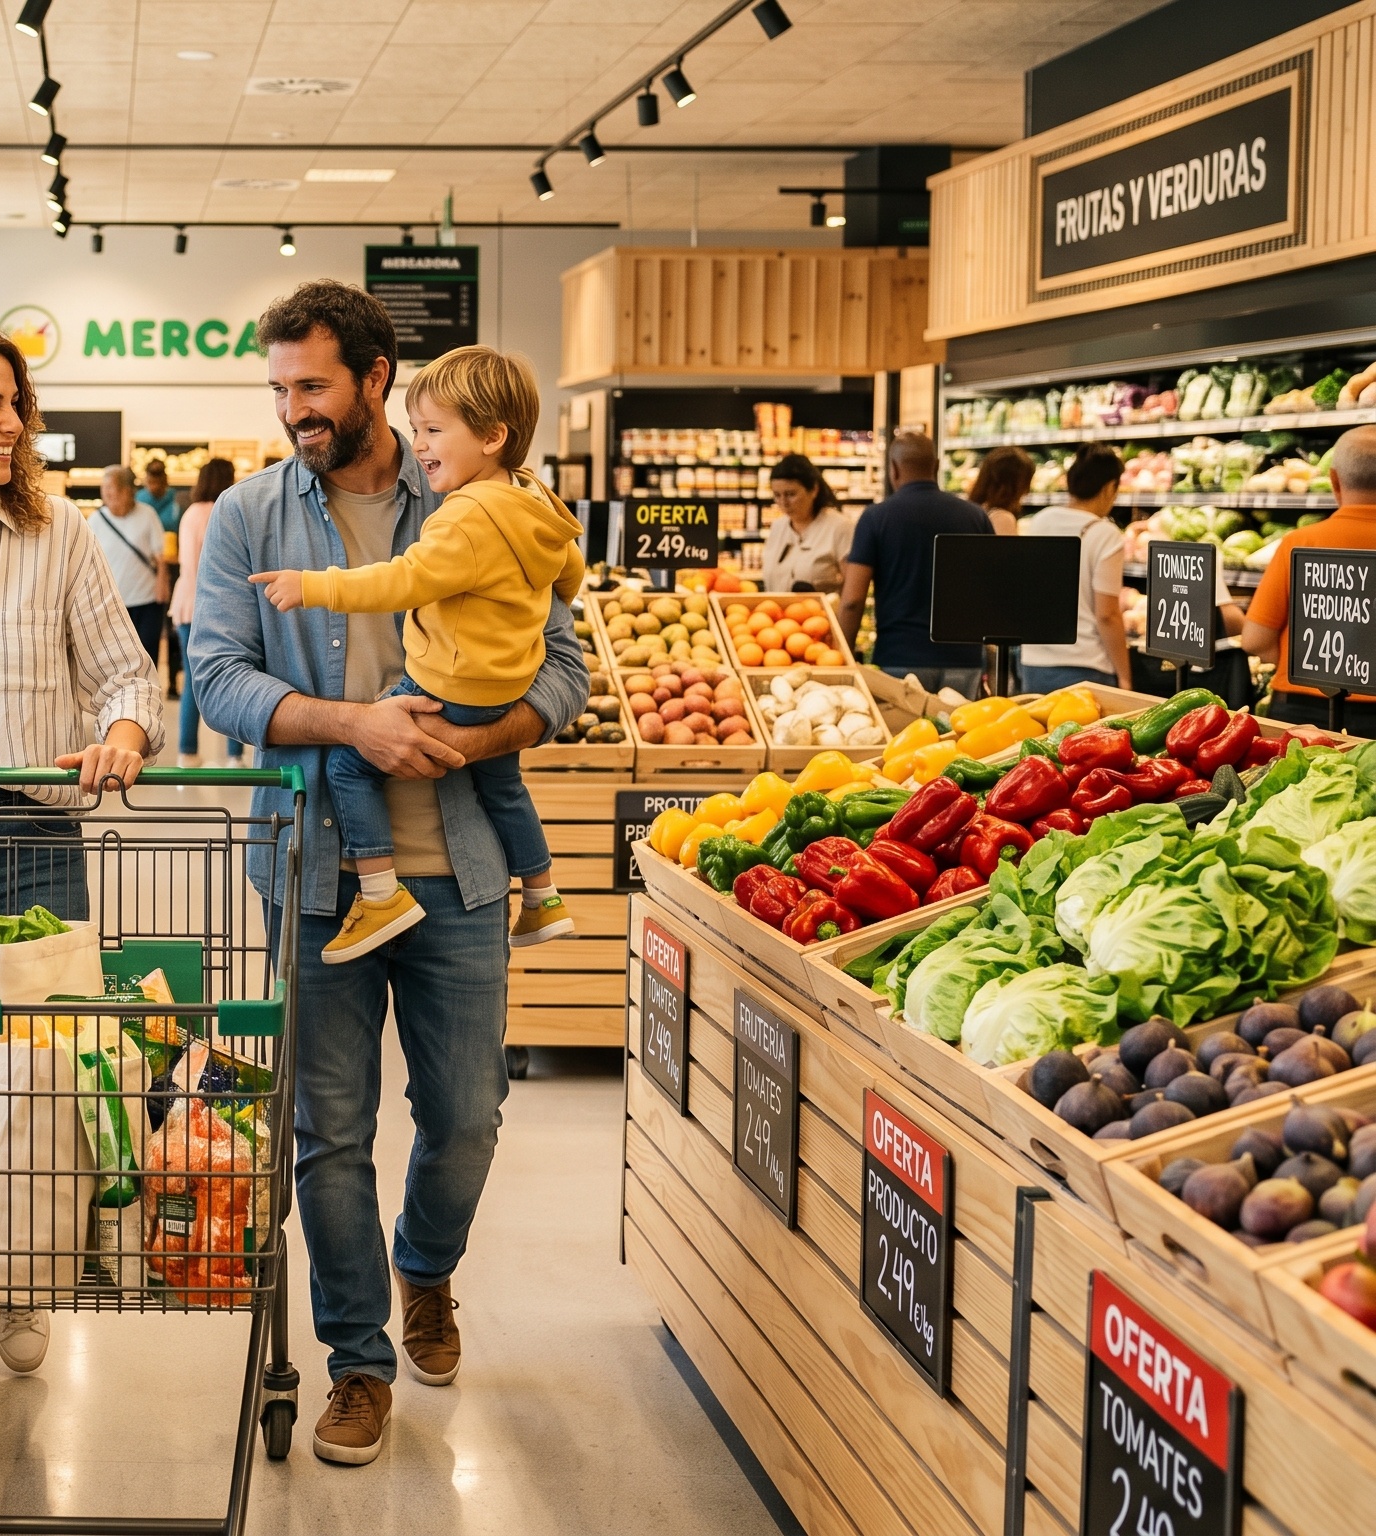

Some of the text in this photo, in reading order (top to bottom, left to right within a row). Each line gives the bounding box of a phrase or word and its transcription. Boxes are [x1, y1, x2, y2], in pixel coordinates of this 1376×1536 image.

[1055, 136, 1267, 247] FRUTAS Y VERDURAS
[636, 505, 709, 525] OFERTA
[1302, 593, 1371, 624] VERDURAS
[1304, 562, 1369, 591] FRUTAS Y
[646, 929, 680, 981] OFERTA
[739, 1001, 786, 1068] FRUTERÍA
[742, 1056, 782, 1115] TOMATES
[873, 1110, 934, 1195] OFERTA
[868, 1169, 938, 1265] PRODUCTO
[1104, 1304, 1209, 1439] OFERTA
[1100, 1381, 1203, 1520] TOMATES
